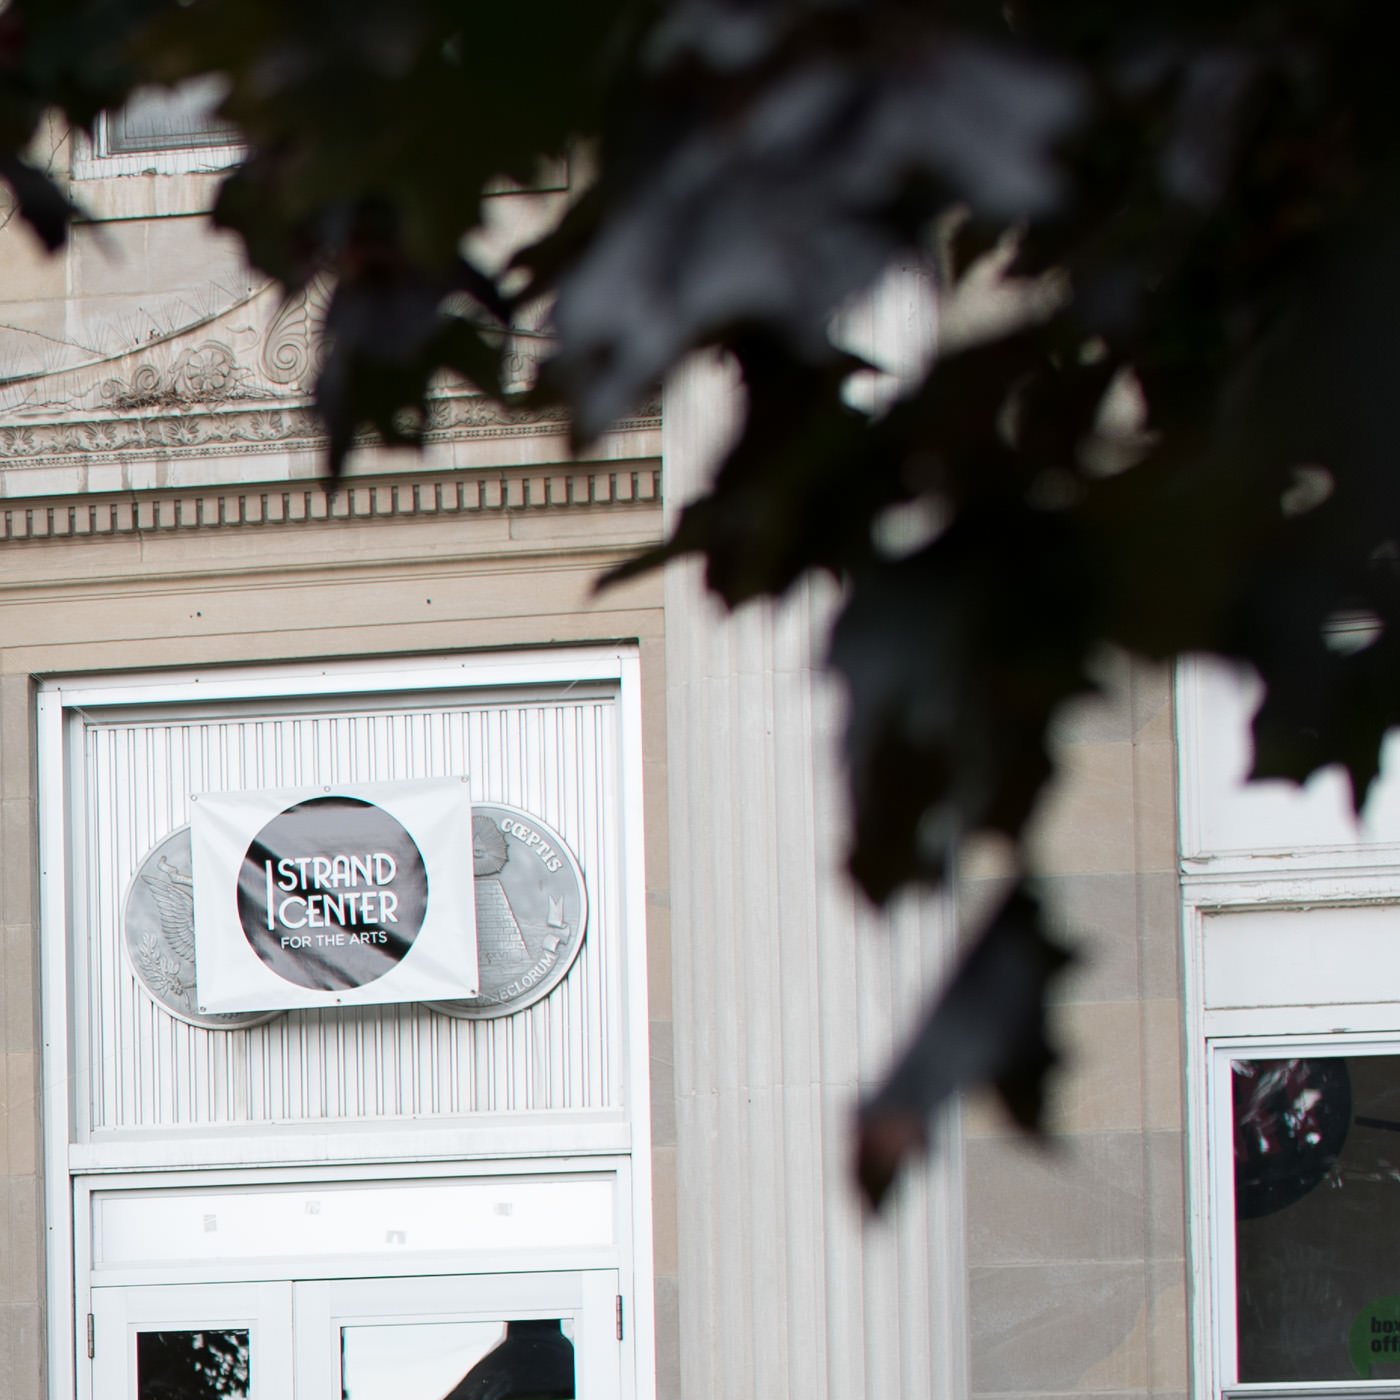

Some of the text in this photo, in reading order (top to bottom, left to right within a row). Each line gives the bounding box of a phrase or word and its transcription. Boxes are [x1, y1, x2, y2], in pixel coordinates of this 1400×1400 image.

[278, 853, 396, 891] STRAND
[279, 890, 399, 929] CENTER
[281, 930, 388, 950] FOR THE ARTS
[1371, 1335, 1400, 1353] off
